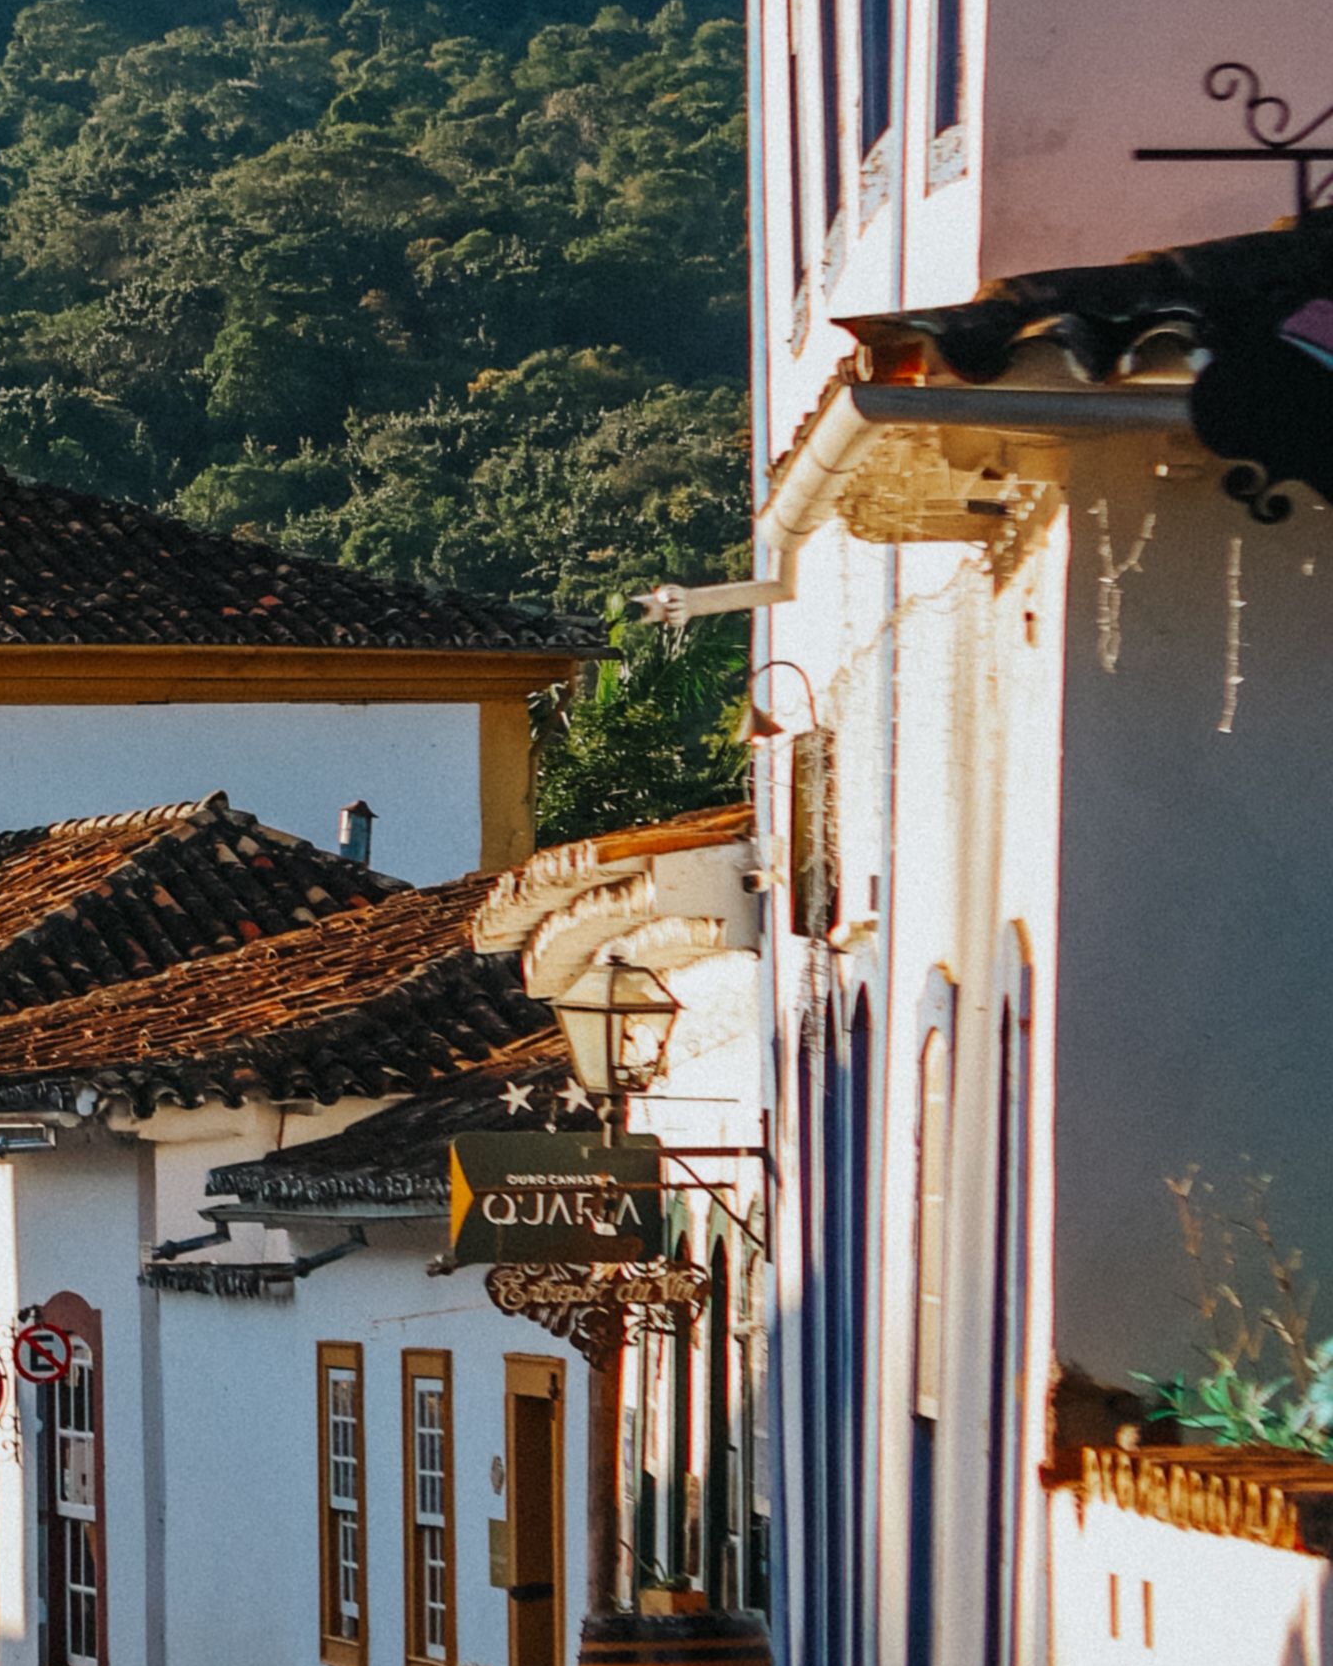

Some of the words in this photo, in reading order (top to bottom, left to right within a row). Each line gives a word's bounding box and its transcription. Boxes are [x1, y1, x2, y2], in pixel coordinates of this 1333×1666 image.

[506, 1173, 547, 1186] OURO
[615, 1276, 653, 1304] du
[30, 1334, 55, 1372] E
